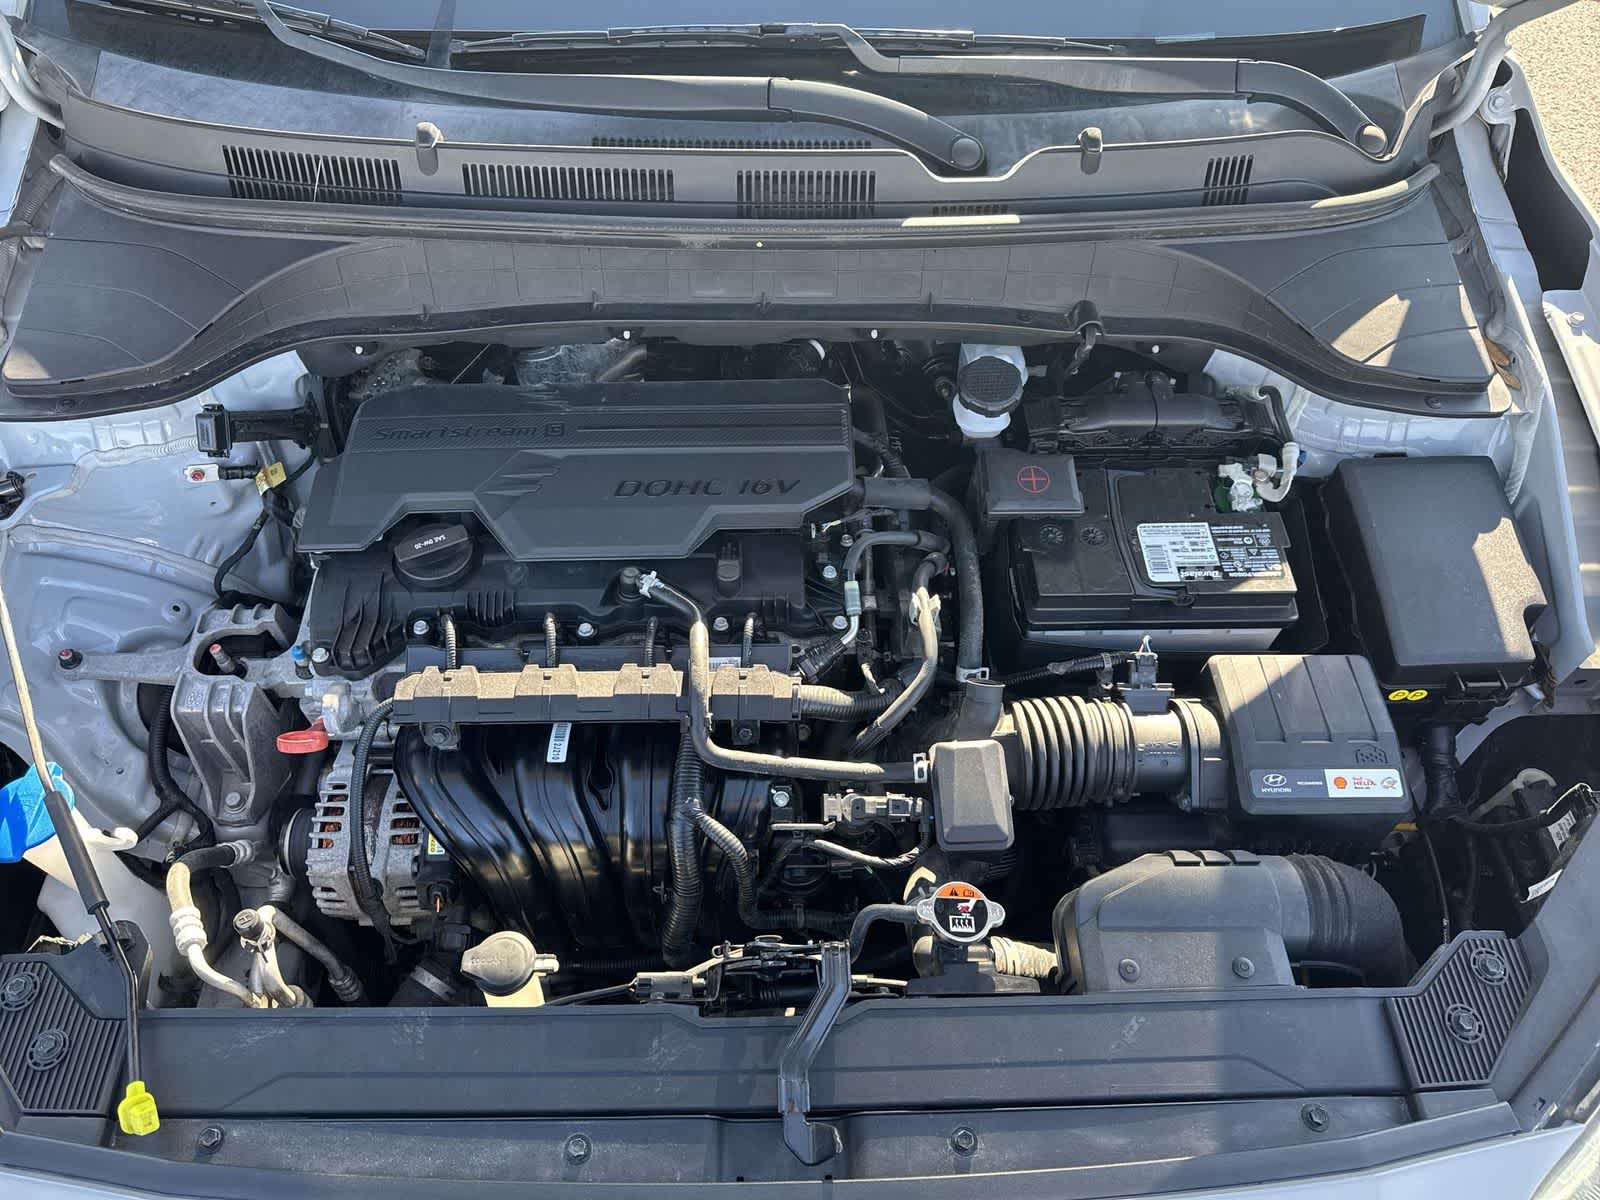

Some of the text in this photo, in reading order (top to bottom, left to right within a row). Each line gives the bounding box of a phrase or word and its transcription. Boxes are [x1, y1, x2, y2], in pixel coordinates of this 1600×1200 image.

[374, 424, 538, 441] Smartstream
[613, 478, 801, 497] DOHC 16V
[433, 534, 446, 543] SAE
